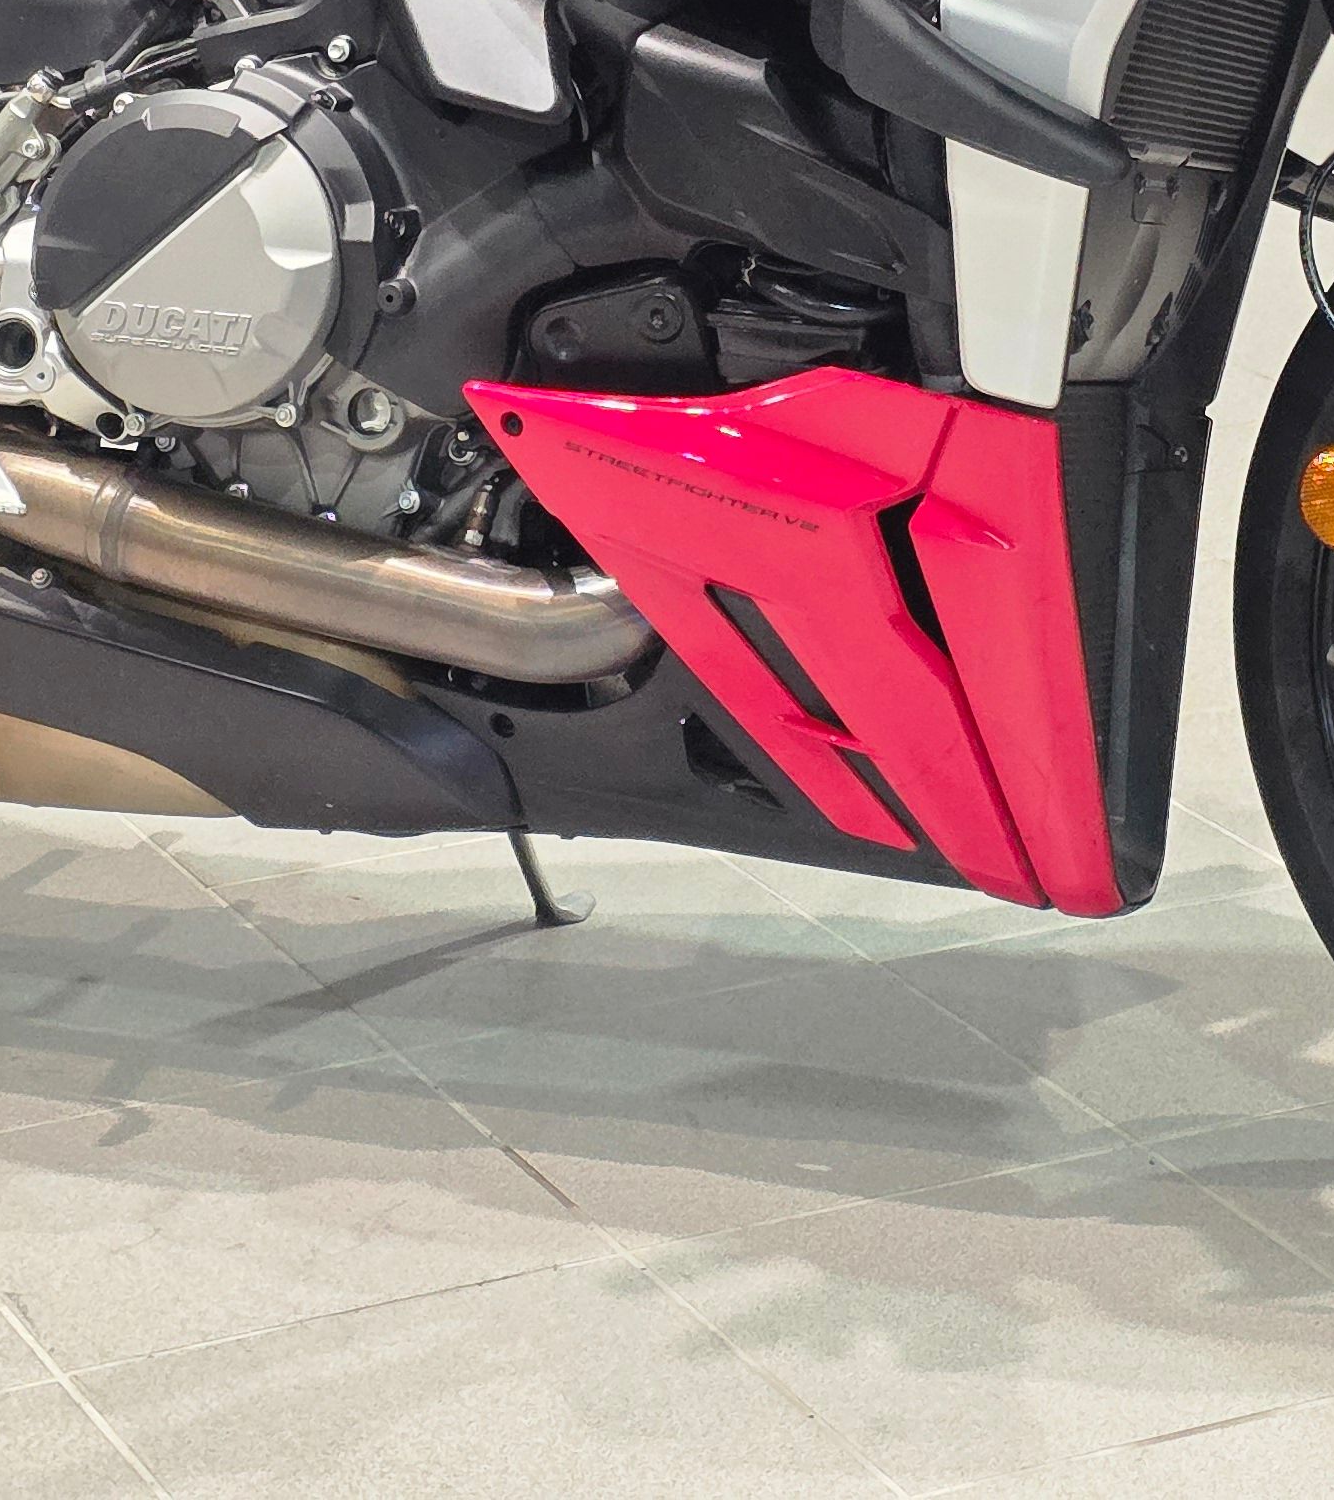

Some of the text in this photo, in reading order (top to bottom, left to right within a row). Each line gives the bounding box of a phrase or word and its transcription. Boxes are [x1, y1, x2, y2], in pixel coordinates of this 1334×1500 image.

[93, 300, 253, 346] DUCATI
[563, 440, 821, 533] STREETFIGHTER V2
